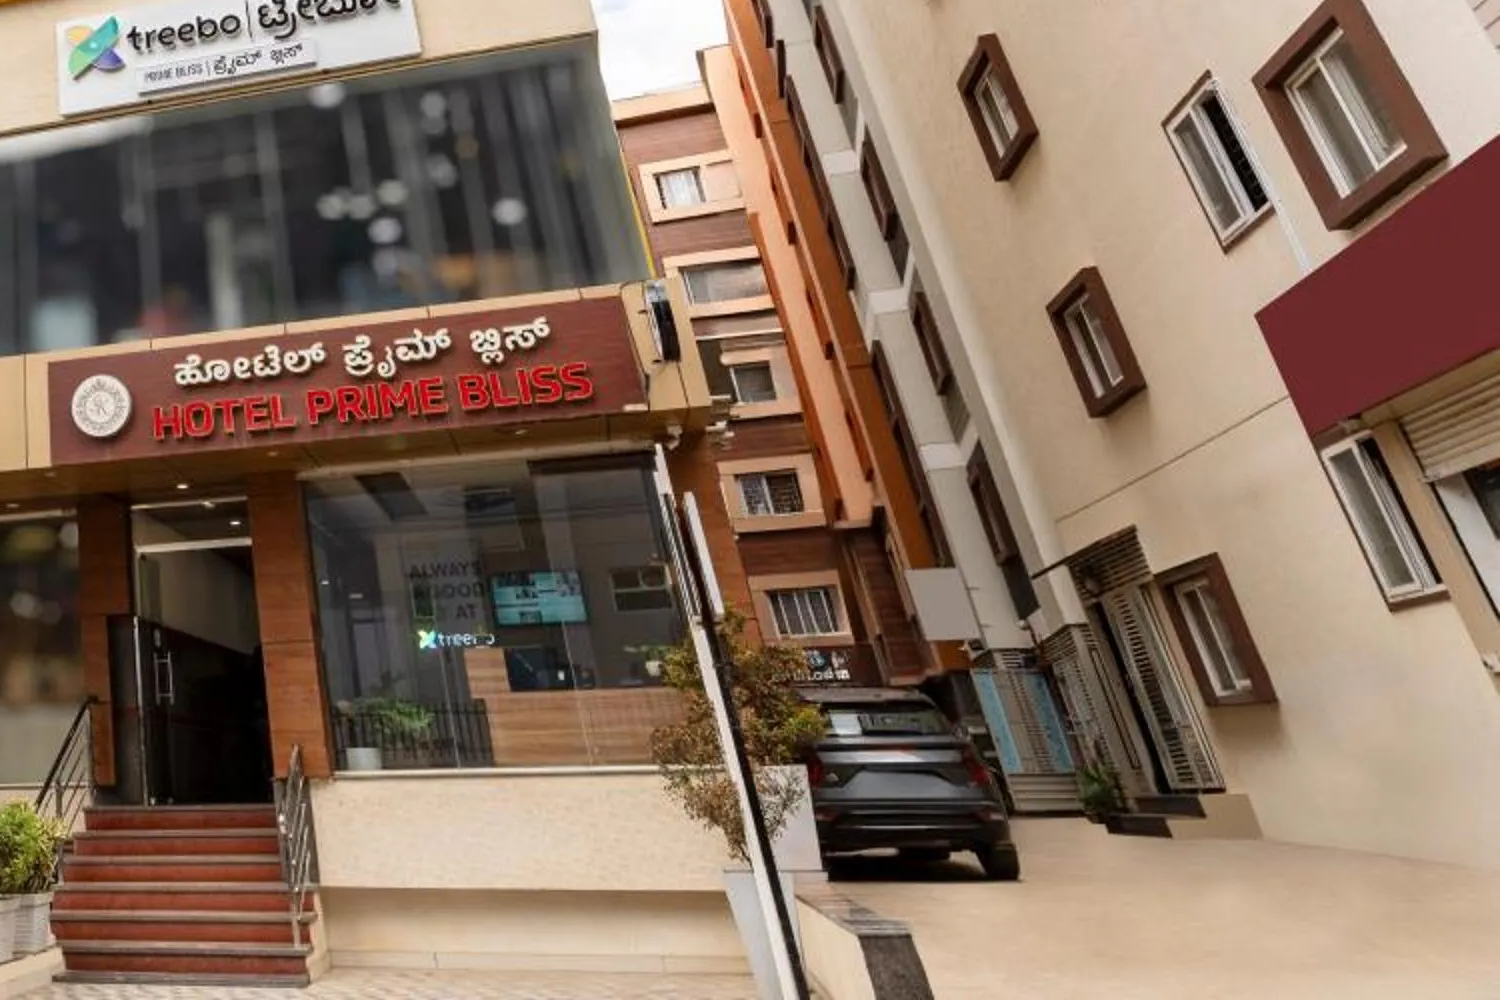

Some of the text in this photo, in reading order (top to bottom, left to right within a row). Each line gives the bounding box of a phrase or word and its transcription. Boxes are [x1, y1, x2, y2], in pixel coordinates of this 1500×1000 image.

[127, 14, 242, 50] treebo
[173, 316, 550, 386] ಹೋಟೆಲ್ ಪ್ರೈಮ್ ಬ್ಲಿಸ್
[152, 392, 297, 442] HOTEL
[307, 375, 450, 426] PRIME
[457, 361, 593, 412] BLISS
